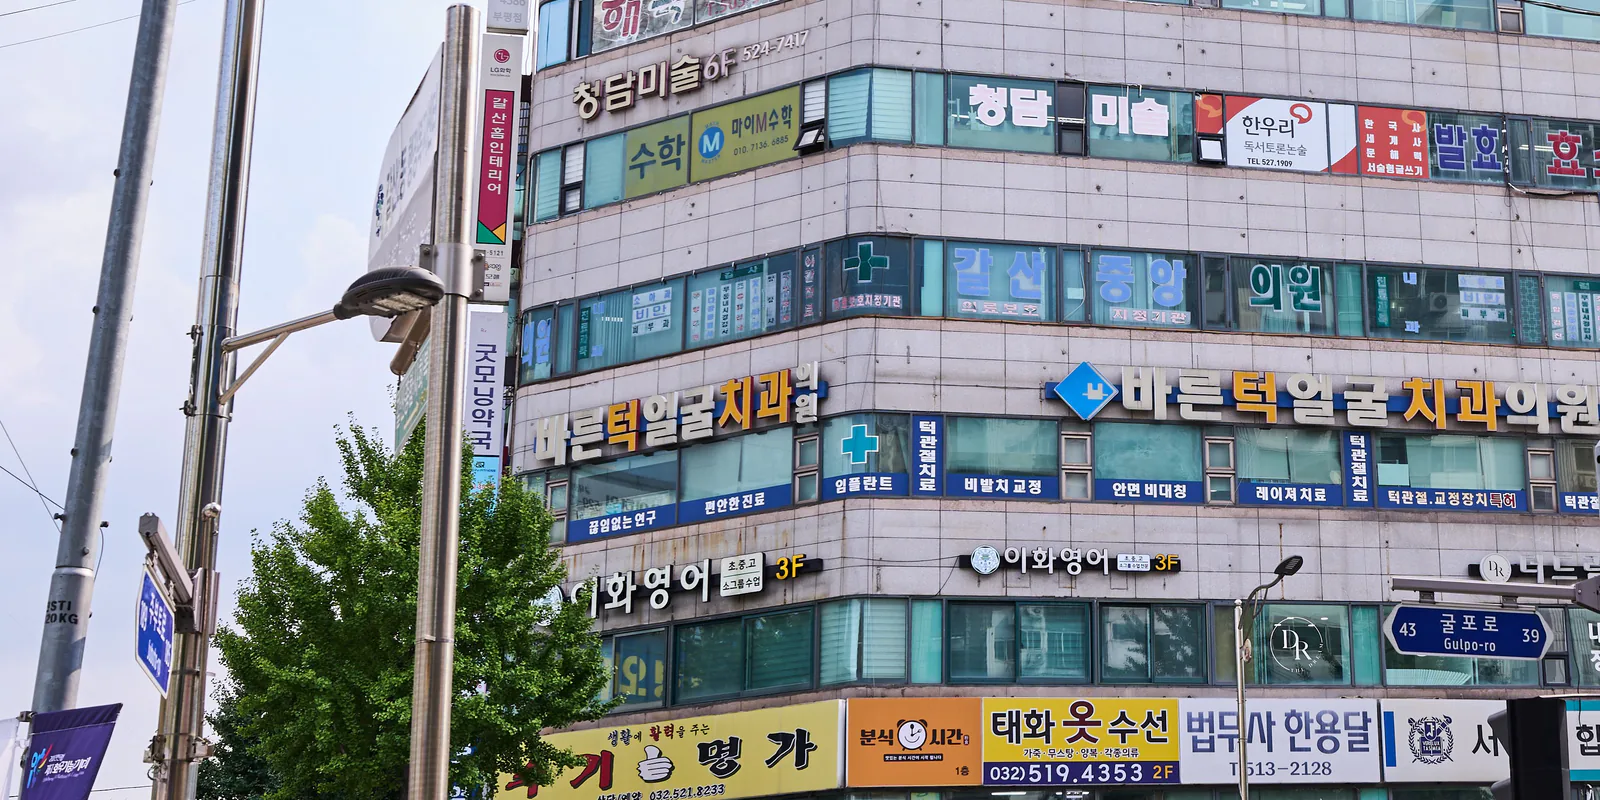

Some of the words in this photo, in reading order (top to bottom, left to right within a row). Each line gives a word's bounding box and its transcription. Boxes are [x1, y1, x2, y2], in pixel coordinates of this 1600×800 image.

[493, 12, 522, 23] 부평점
[573, 54, 701, 120] 청담미술
[703, 49, 736, 81] 6F
[743, 30, 810, 62] 524-7417
[731, 104, 793, 138] 마이M수학
[969, 84, 1052, 127] 청담
[1092, 97, 1169, 137] 미술
[1242, 115, 1295, 139] 한우리
[487, 97, 508, 195] 갈산홈인테리어
[629, 134, 685, 179] 수학
[1243, 140, 1308, 157] 독서토론논술
[1434, 123, 1503, 171] 발효
[1262, 159, 1293, 168] 527.1909
[1367, 162, 1423, 176] 서술형글쓰기
[953, 248, 1046, 299] 갈산
[1096, 255, 1186, 307] 중앙
[1250, 264, 1322, 313] 의원
[636, 304, 667, 320] 비만
[961, 301, 1040, 317] 의료보호
[1112, 308, 1187, 325] 지정기관
[471, 343, 497, 450] 굿모닝약국
[918, 420, 937, 491] 턱관절치료
[1350, 435, 1368, 502] 턱관절치료
[835, 476, 893, 494] 임플란트
[964, 477, 1009, 494] 비발치
[1013, 479, 1042, 495] 교정
[1112, 482, 1140, 497] 안면
[1144, 484, 1187, 499] 비대칭
[704, 496, 740, 515] 편안한
[742, 491, 765, 508] 진료
[634, 510, 656, 527] 연구
[775, 553, 805, 580] 3F
[1004, 546, 1109, 576] 이화영어
[1154, 553, 1179, 571] 3F
[1399, 622, 1417, 637] 43
[1440, 613, 1499, 634] 굴포로
[1443, 637, 1496, 653] Gulpo-ro
[1522, 628, 1540, 643] 39
[991, 708, 1055, 745] 태화
[1062, 699, 1102, 744] 옷
[1107, 709, 1169, 743] 수선
[1186, 710, 1276, 753] 법무사
[1284, 709, 1372, 754] 한용달
[607, 730, 642, 747] 생활에
[649, 723, 686, 742] 활력을
[689, 723, 710, 736] 주는
[860, 729, 894, 746] 분식
[929, 728, 963, 746] 시간
[1048, 748, 1074, 759] 무스탕
[1104, 748, 1140, 759] 각종의류
[955, 766, 970, 776] 1층
[1152, 765, 1174, 779] 2F
[649, 784, 726, 800] 032.521.8233
